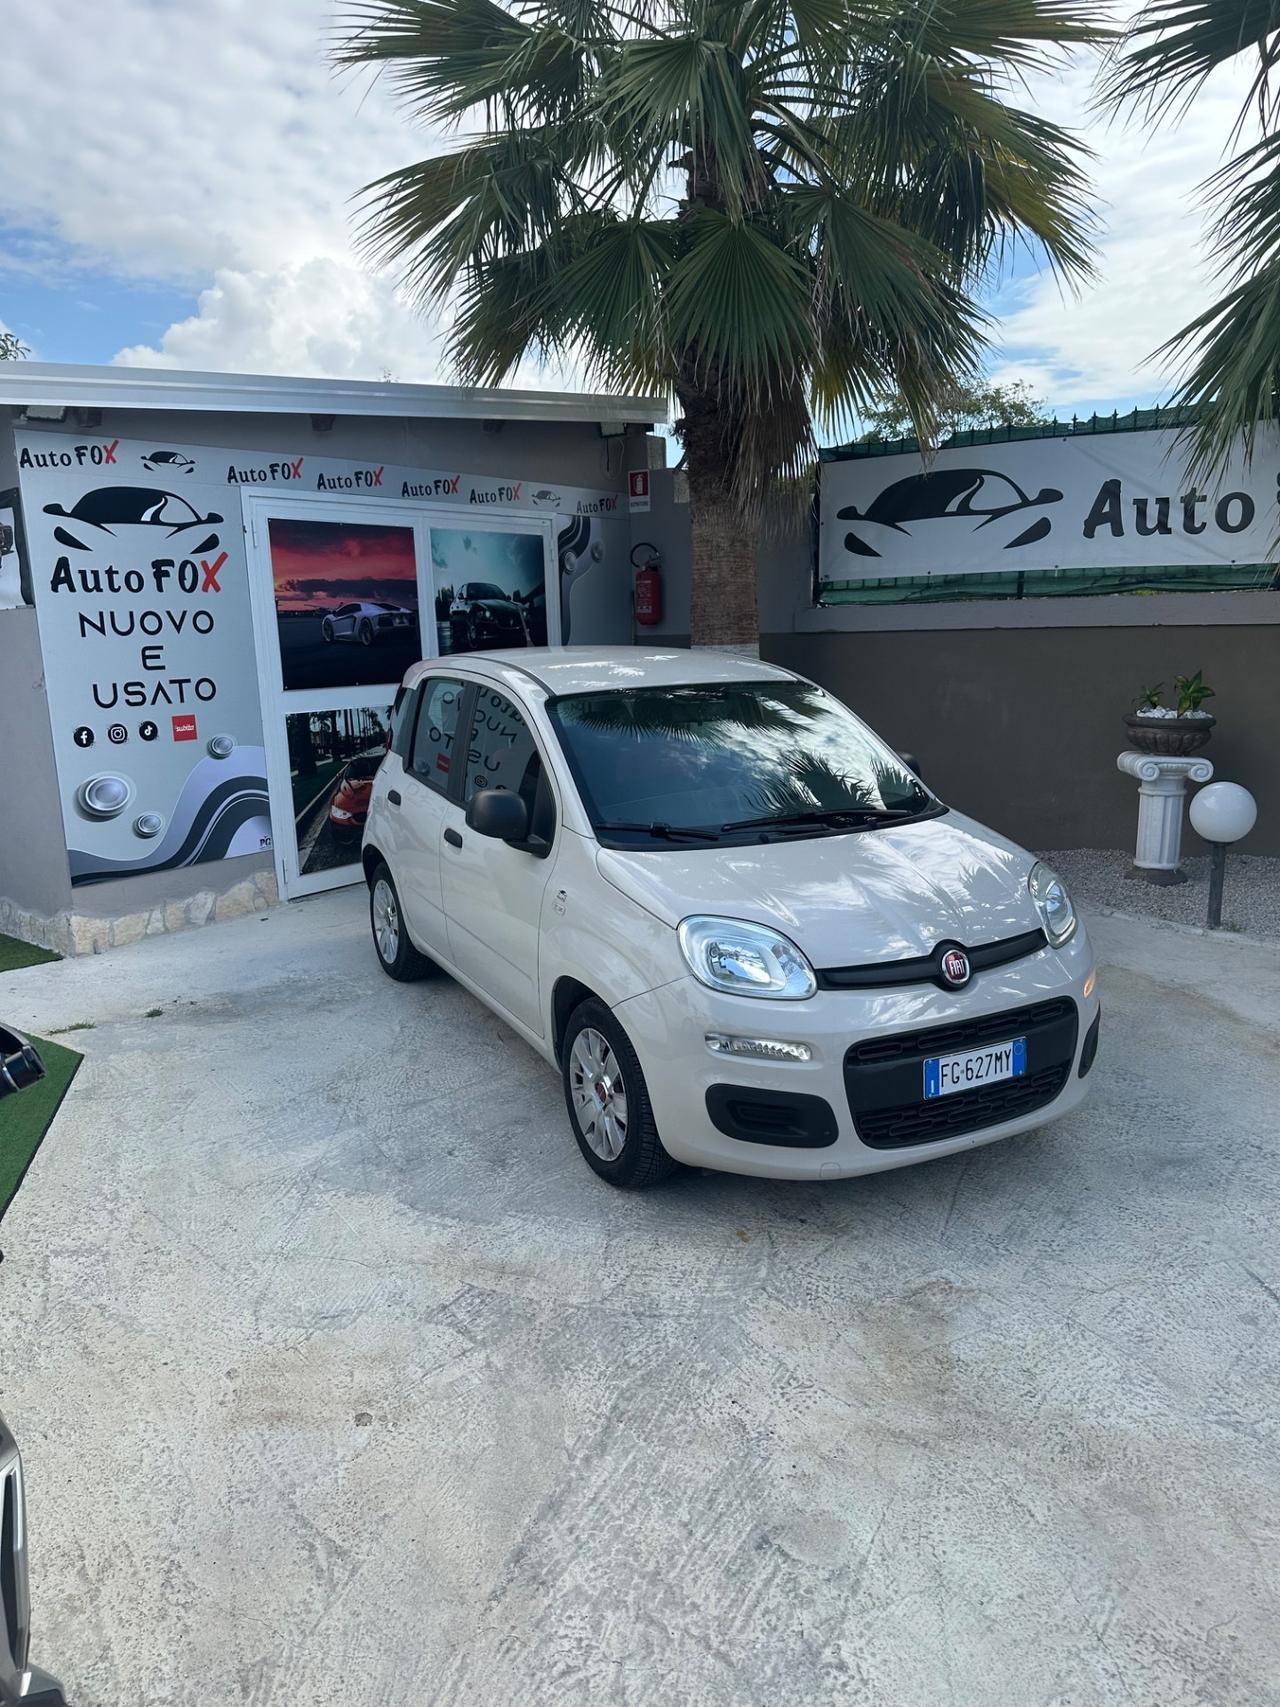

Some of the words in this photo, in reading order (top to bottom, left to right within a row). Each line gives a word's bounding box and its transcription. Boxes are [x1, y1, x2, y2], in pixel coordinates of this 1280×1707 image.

[19, 447, 72, 469] Auto
[74, 439, 120, 465] FOX
[227, 465, 267, 484] Auto
[269, 457, 304, 481] FOX
[316, 472, 352, 490] Auto
[354, 466, 385, 488] FOX
[401, 481, 432, 498] Auto
[433, 474, 460, 495] FOX
[469, 488, 497, 504] Auto
[498, 482, 522, 502] FOX
[576, 500, 598, 514] Auto
[599, 494, 618, 512] FOX
[1083, 477, 1256, 540] Auto
[50, 556, 145, 593] Auto
[151, 551, 229, 593] FOX
[78, 609, 215, 638] NUOVO
[141, 645, 166, 671] E
[92, 677, 217, 709] USATO
[949, 958, 965, 976] FIAT
